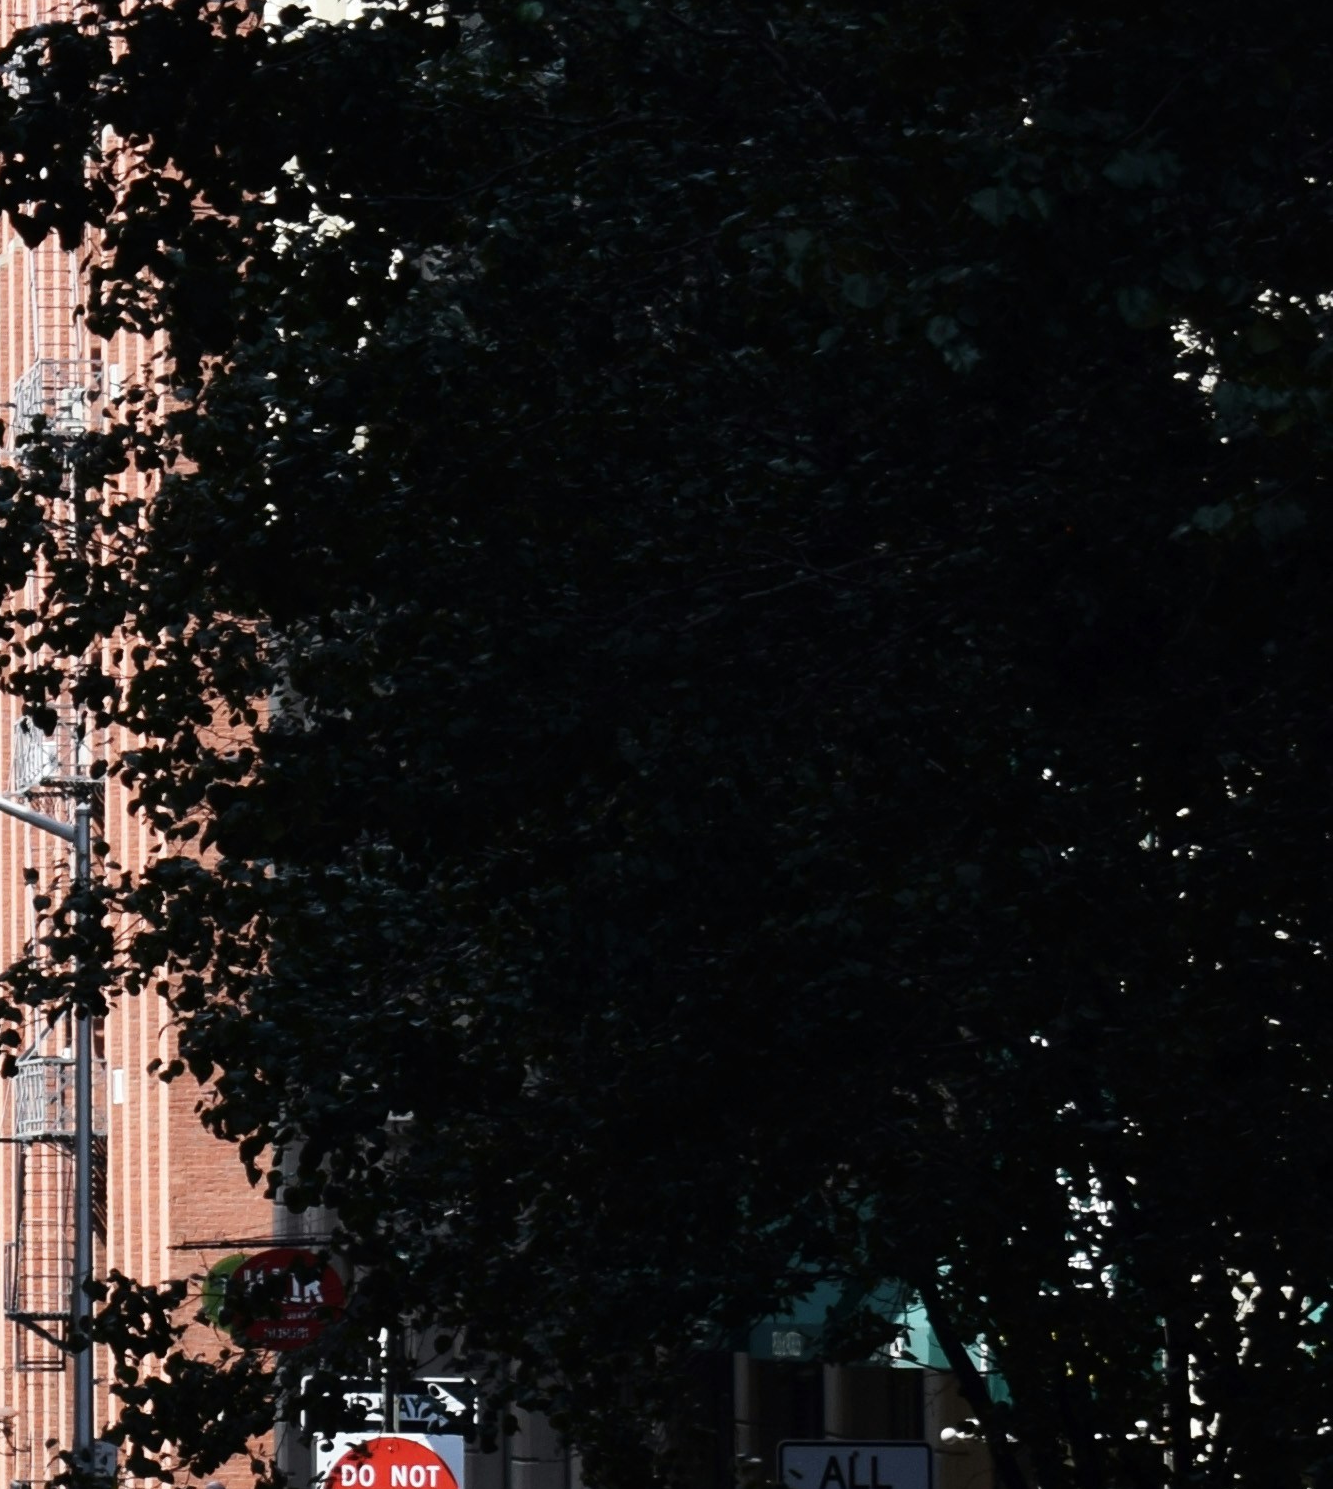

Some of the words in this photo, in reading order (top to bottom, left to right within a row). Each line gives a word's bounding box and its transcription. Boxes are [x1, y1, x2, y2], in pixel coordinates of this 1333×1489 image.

[341, 1464, 375, 1487] DO
[391, 1465, 440, 1488] NOT
[819, 1456, 893, 1489] ALL
